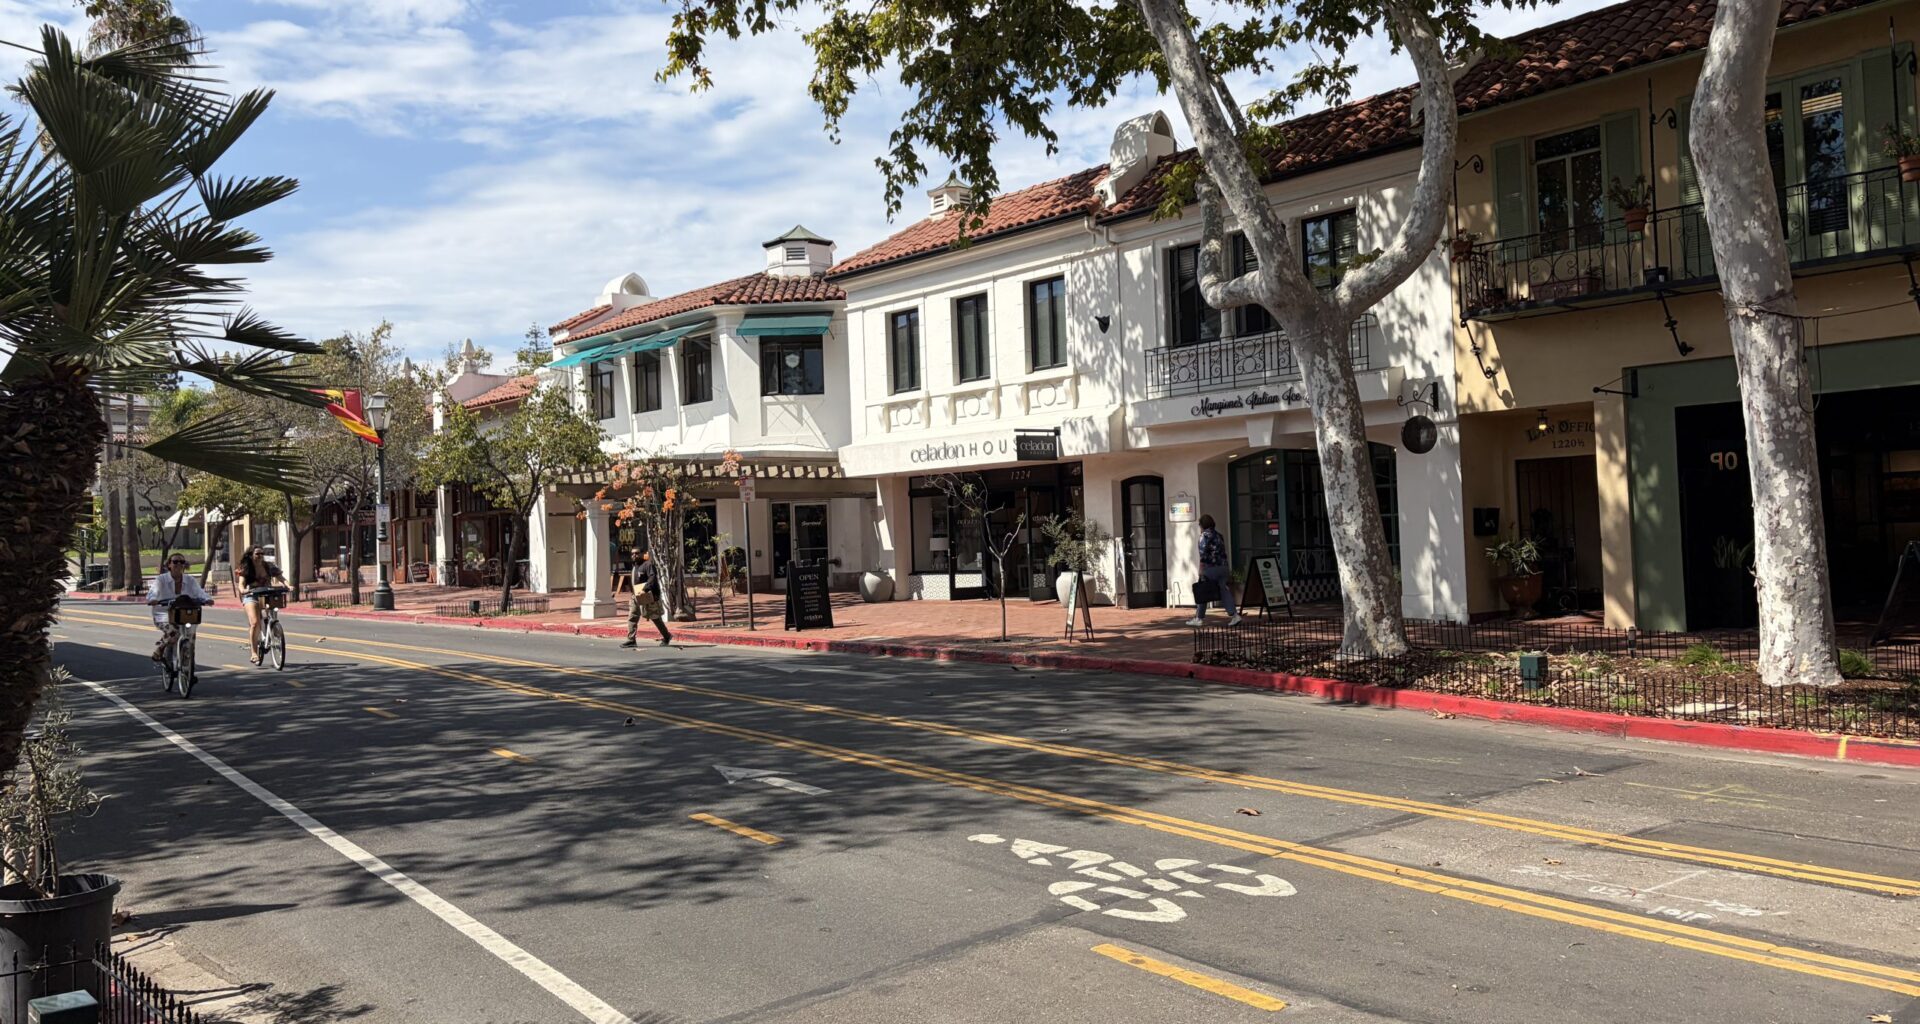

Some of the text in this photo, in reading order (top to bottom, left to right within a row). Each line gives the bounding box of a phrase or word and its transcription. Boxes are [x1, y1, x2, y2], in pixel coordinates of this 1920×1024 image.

[1191, 386, 1302, 417] Mangione's Italian Ice
[1019, 440, 1054, 451] celadon
[911, 442, 965, 463] celadon
[1010, 470, 1031, 481] 1224
[799, 573, 819, 581] OPEN
